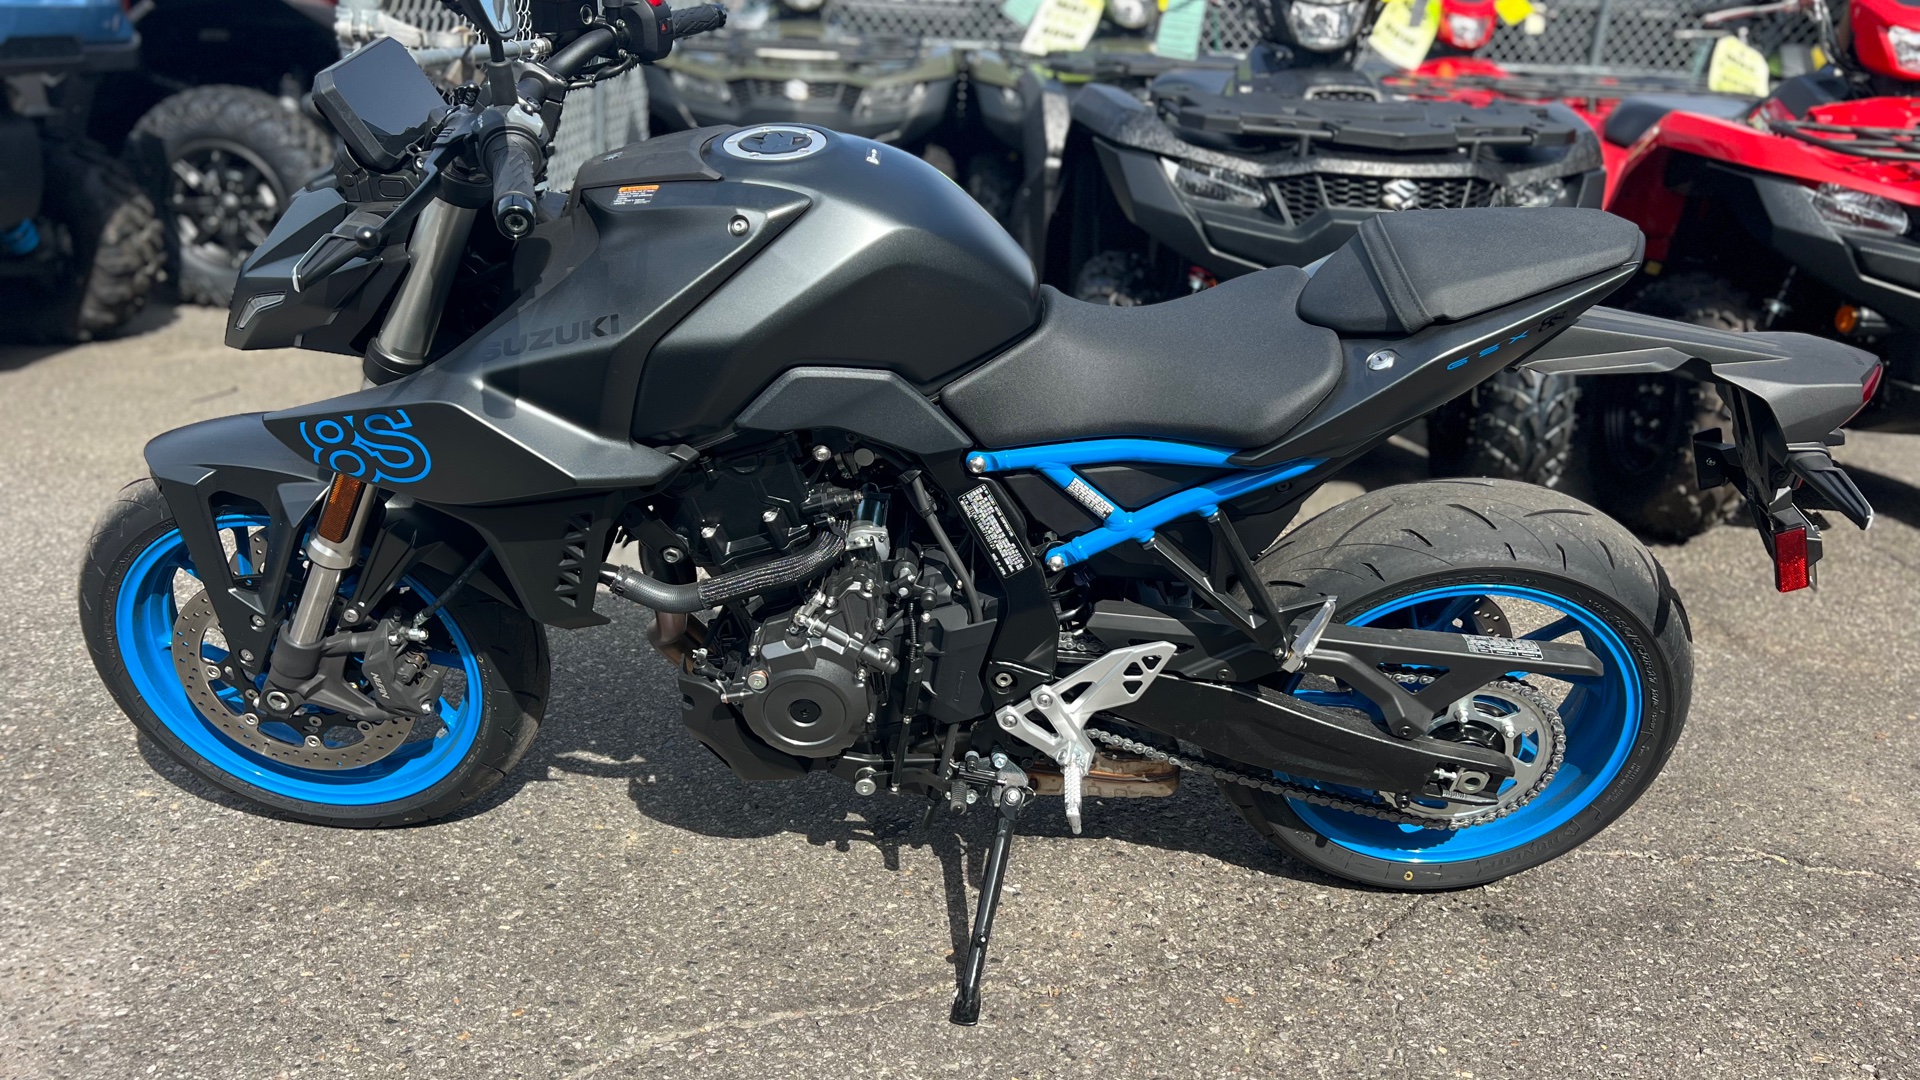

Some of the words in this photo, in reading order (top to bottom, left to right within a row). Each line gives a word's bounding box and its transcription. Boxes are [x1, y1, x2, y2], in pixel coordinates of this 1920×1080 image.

[479, 314, 620, 362] SUZUKI
[1446, 329, 1530, 371] GSX
[299, 409, 432, 483] 8S
